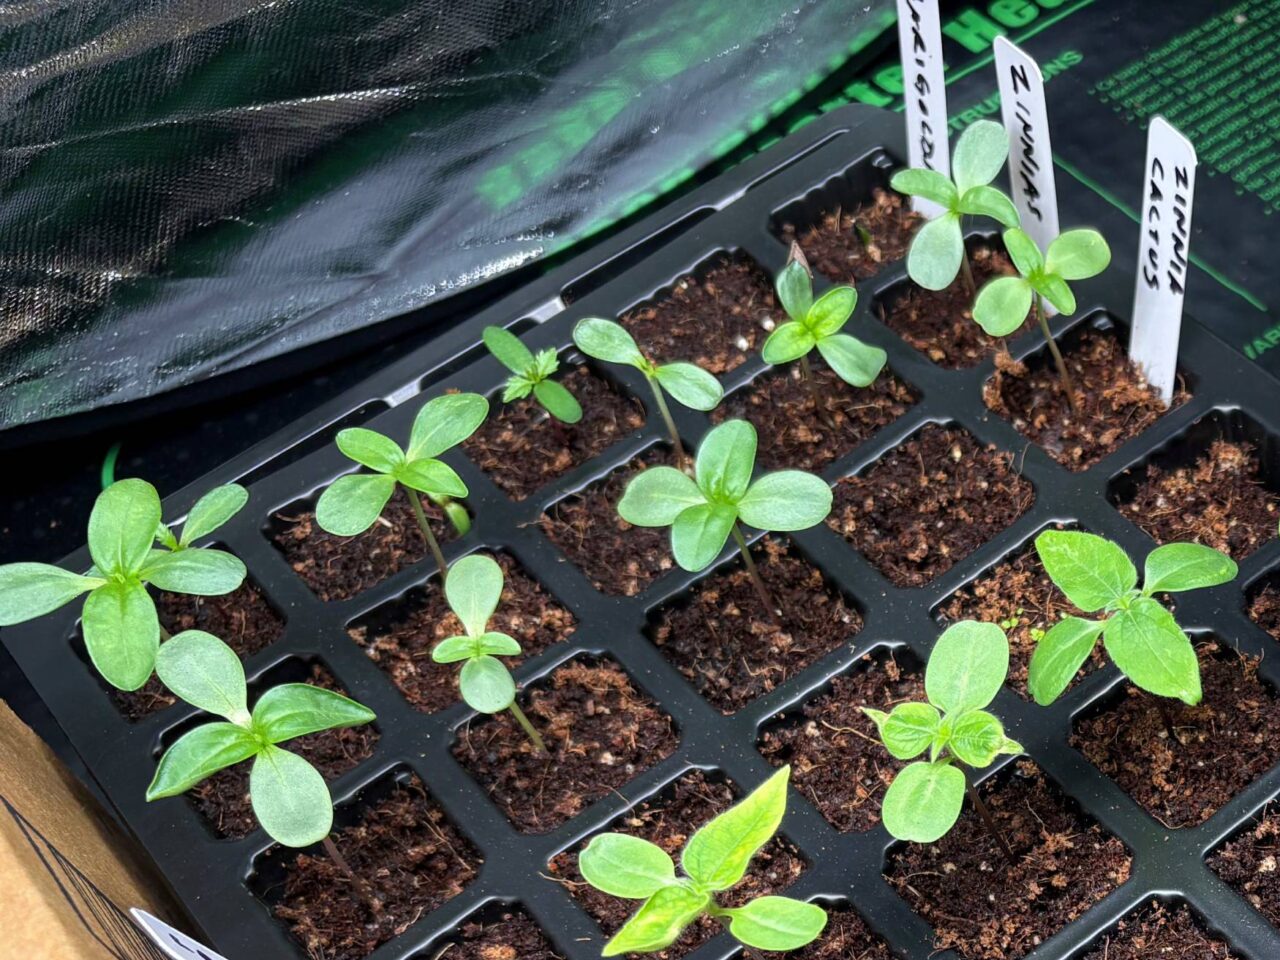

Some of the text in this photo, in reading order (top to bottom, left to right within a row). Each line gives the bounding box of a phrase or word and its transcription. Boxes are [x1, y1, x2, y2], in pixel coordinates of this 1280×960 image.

[1010, 64, 1043, 222] ZINNIAS
[1143, 157, 1165, 291] CACTUS
[1167, 165, 1189, 296] ZINNIA
